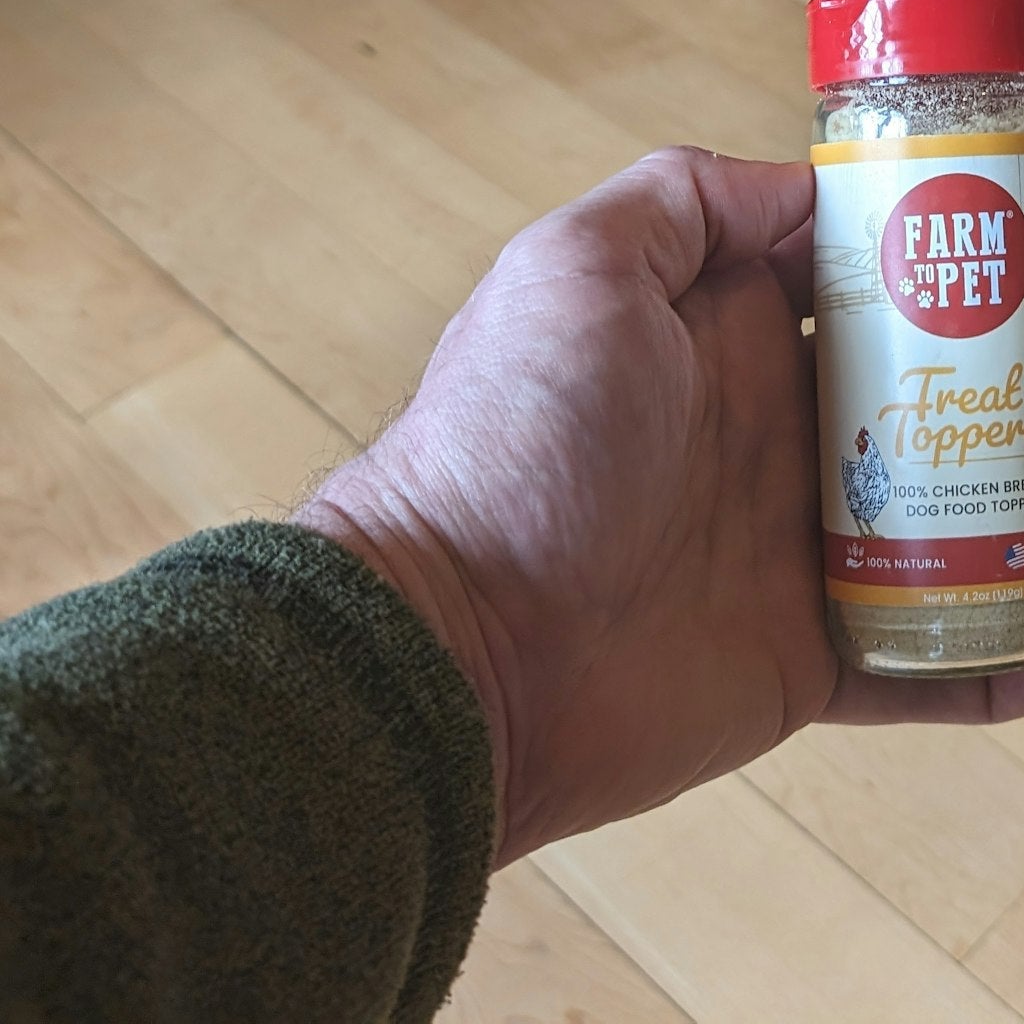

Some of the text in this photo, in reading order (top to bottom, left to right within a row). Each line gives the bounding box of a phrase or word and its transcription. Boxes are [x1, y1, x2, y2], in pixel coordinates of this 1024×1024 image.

[914, 259, 1006, 308] TO PET
[898, 361, 1024, 422] Treat
[893, 485, 928, 498] 100%
[932, 481, 999, 498] CHICKEN
[906, 504, 939, 517] DOG
[944, 502, 986, 516] FOOD
[866, 557, 947, 569] 100% NATURAL
[923, 593, 941, 604] Net
[963, 591, 990, 602] 4.2oz
[992, 587, 1023, 602] (119g)
